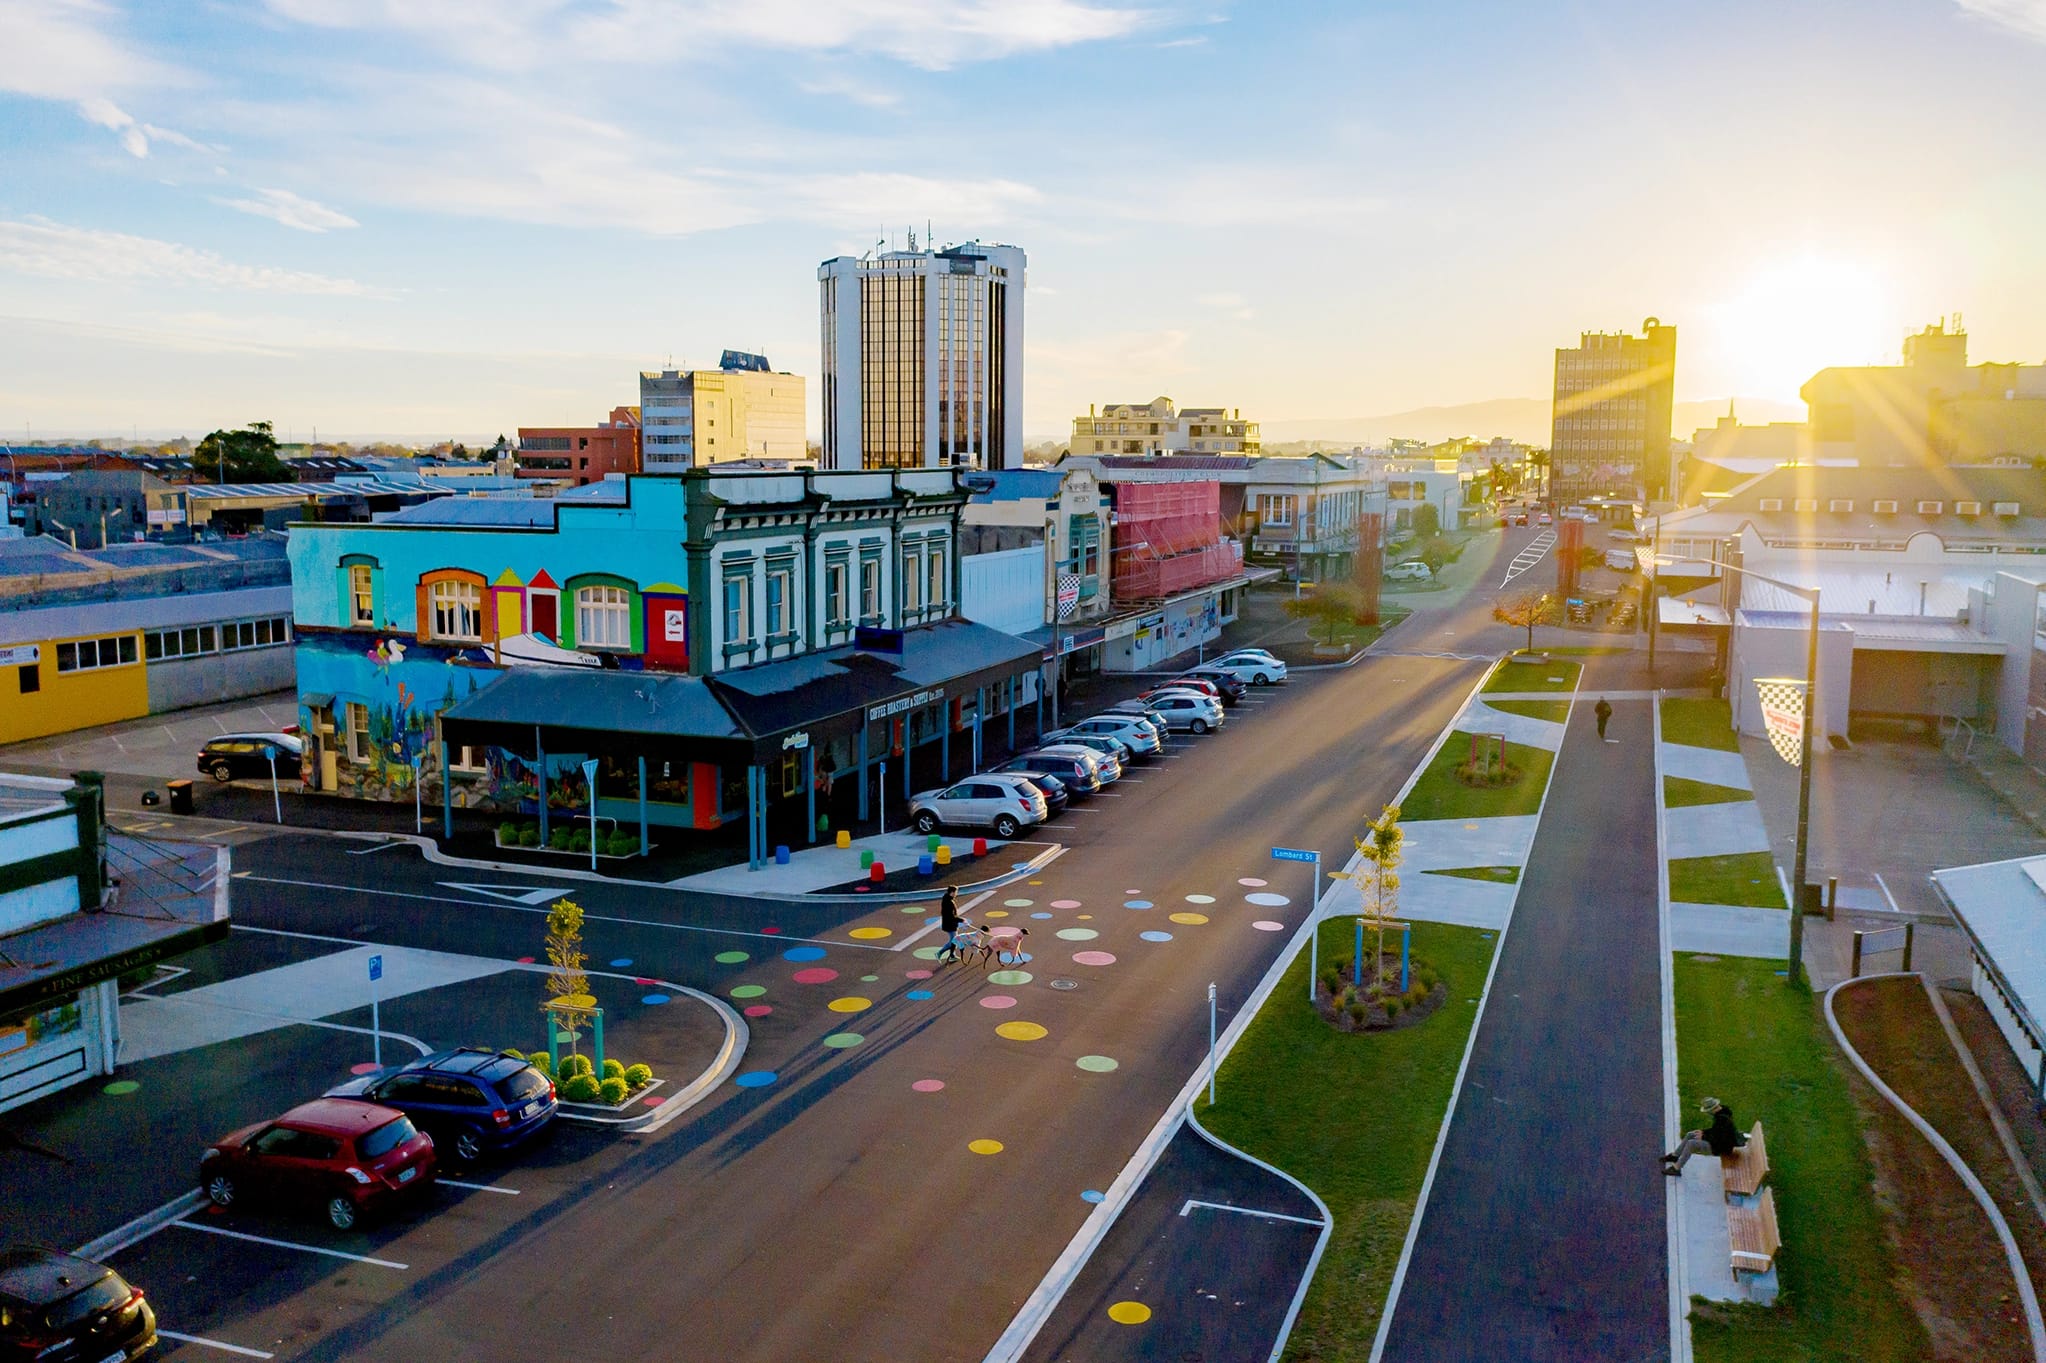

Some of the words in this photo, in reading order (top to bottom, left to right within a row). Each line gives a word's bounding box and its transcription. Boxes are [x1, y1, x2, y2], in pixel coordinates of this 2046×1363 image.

[869, 704, 886, 720] COFFEE
[1274, 850, 1303, 860] Lombard
[1304, 853, 1313, 861] St
[52, 975, 81, 992] FINE
[89, 952, 153, 978] SAUSAGES
